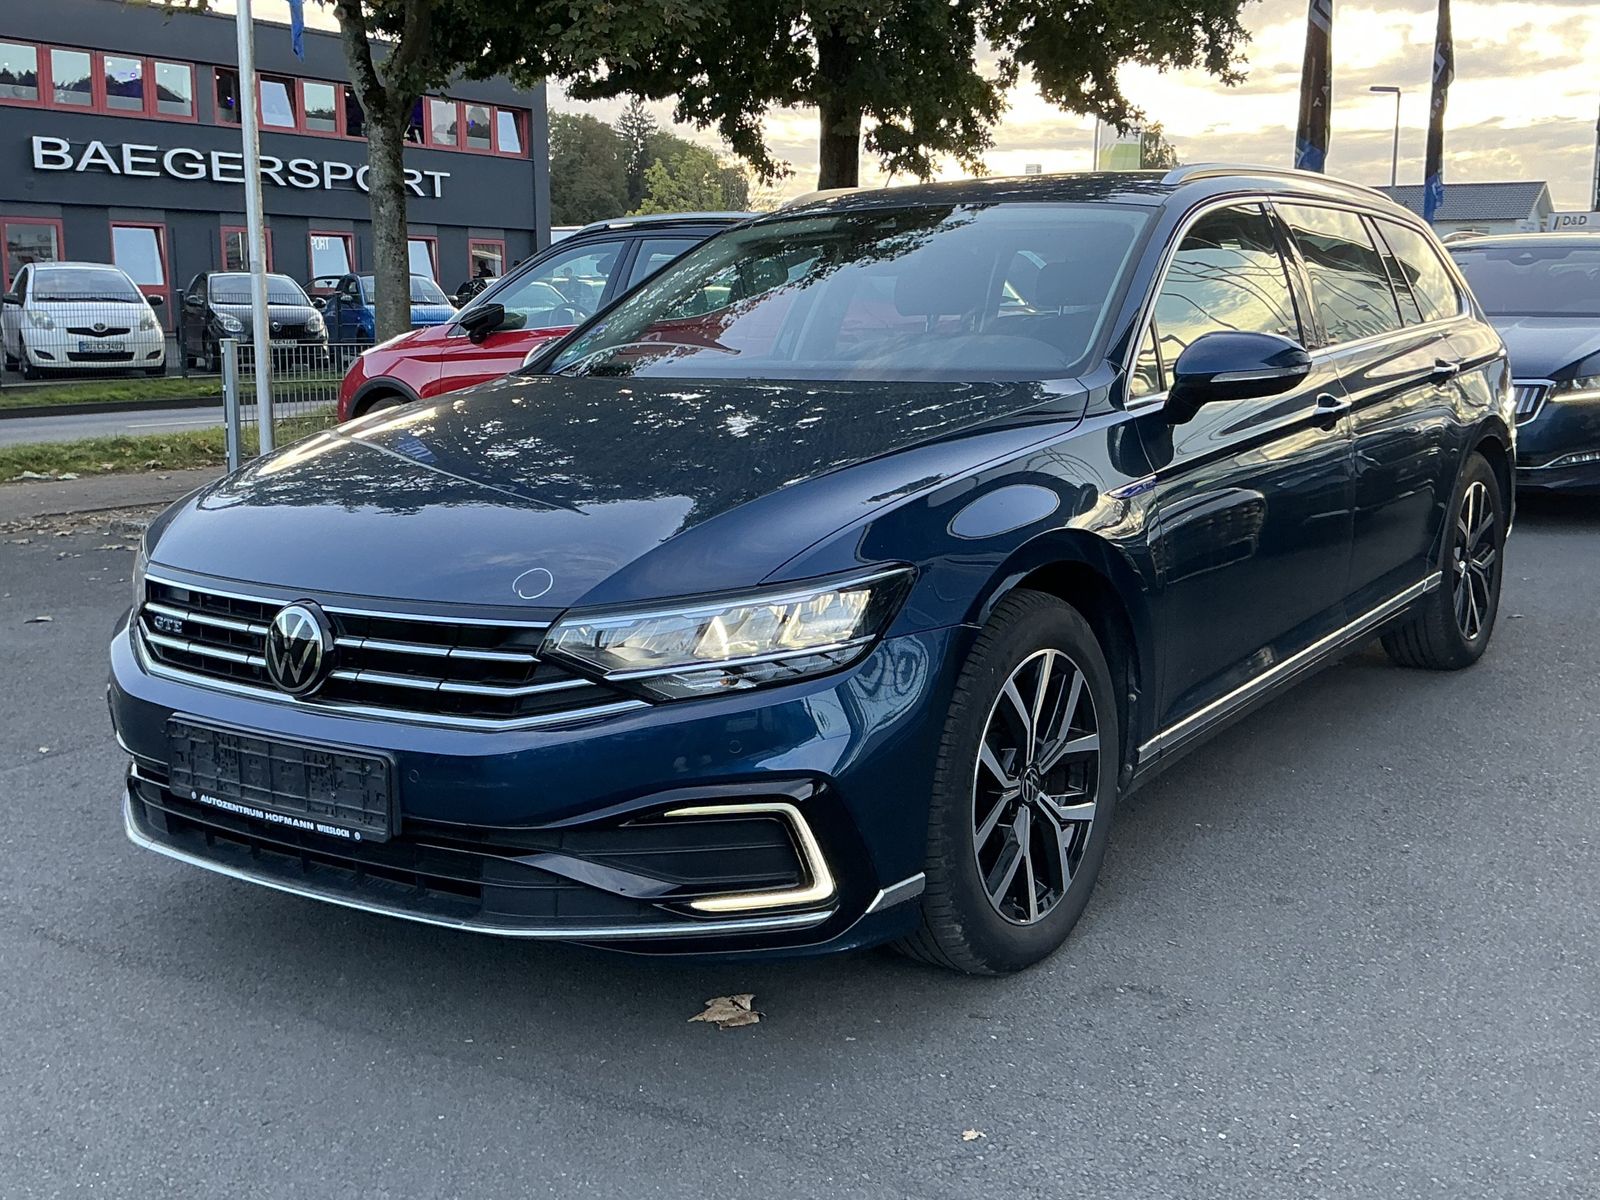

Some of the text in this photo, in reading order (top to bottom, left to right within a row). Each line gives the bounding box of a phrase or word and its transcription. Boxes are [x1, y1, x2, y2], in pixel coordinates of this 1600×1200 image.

[154, 615, 182, 633] GTE
[200, 794, 350, 838] AUTOZENTRUM HOFMANN WIESLOCH
